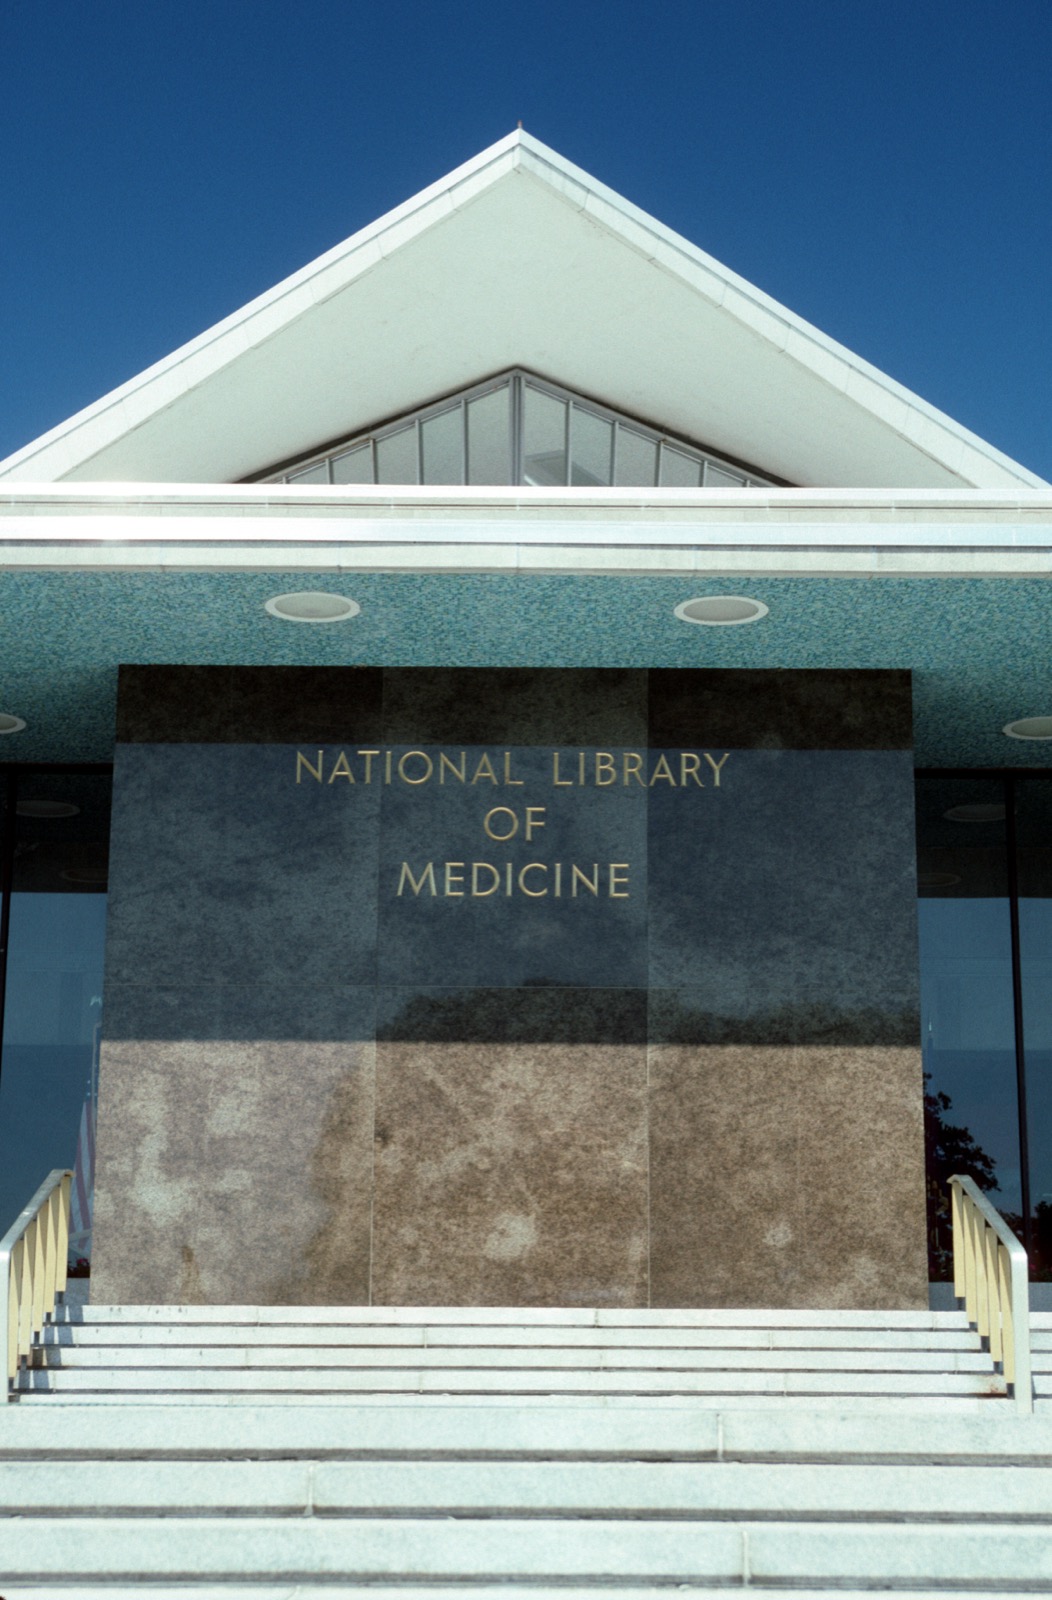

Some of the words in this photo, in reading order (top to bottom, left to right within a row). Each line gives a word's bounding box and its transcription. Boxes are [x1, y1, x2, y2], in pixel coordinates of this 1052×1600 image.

[296, 750, 524, 785] NATIONAL
[553, 752, 730, 788] LIBRARY
[484, 806, 546, 841] OF
[397, 862, 630, 897] MEDICINE
